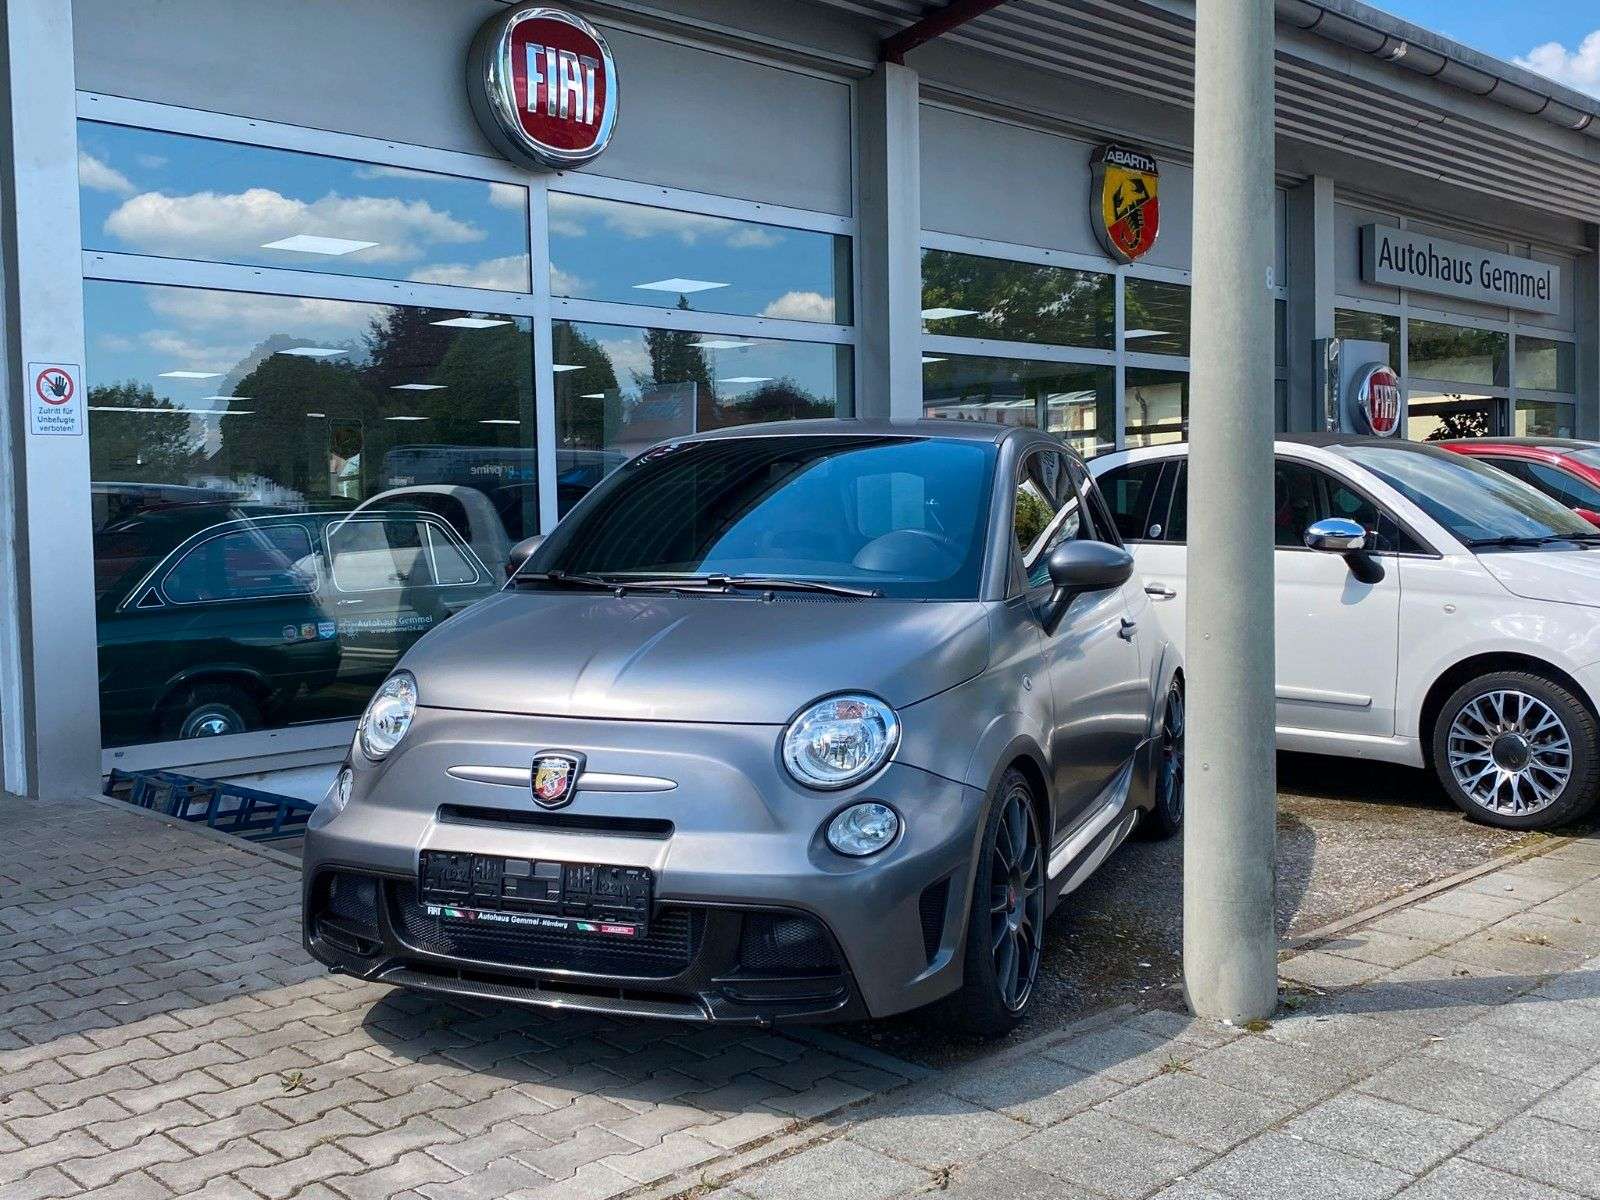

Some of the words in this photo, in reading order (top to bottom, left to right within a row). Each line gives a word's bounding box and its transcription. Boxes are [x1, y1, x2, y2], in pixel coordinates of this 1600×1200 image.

[525, 42, 599, 125] FIAT
[1107, 151, 1155, 171] ABARTH
[1378, 237, 1473, 285] Autohaus
[1479, 259, 1551, 301] Gemmel
[1373, 384, 1396, 419] FIAT
[62, 407, 73, 415] für
[37, 416, 76, 424] Unbefugte
[357, 617, 397, 627] Autohaus
[398, 615, 433, 625] Gemmel
[427, 906, 441, 916] FIAT
[477, 912, 510, 922] Autohaus
[511, 915, 540, 926] Gemmel
